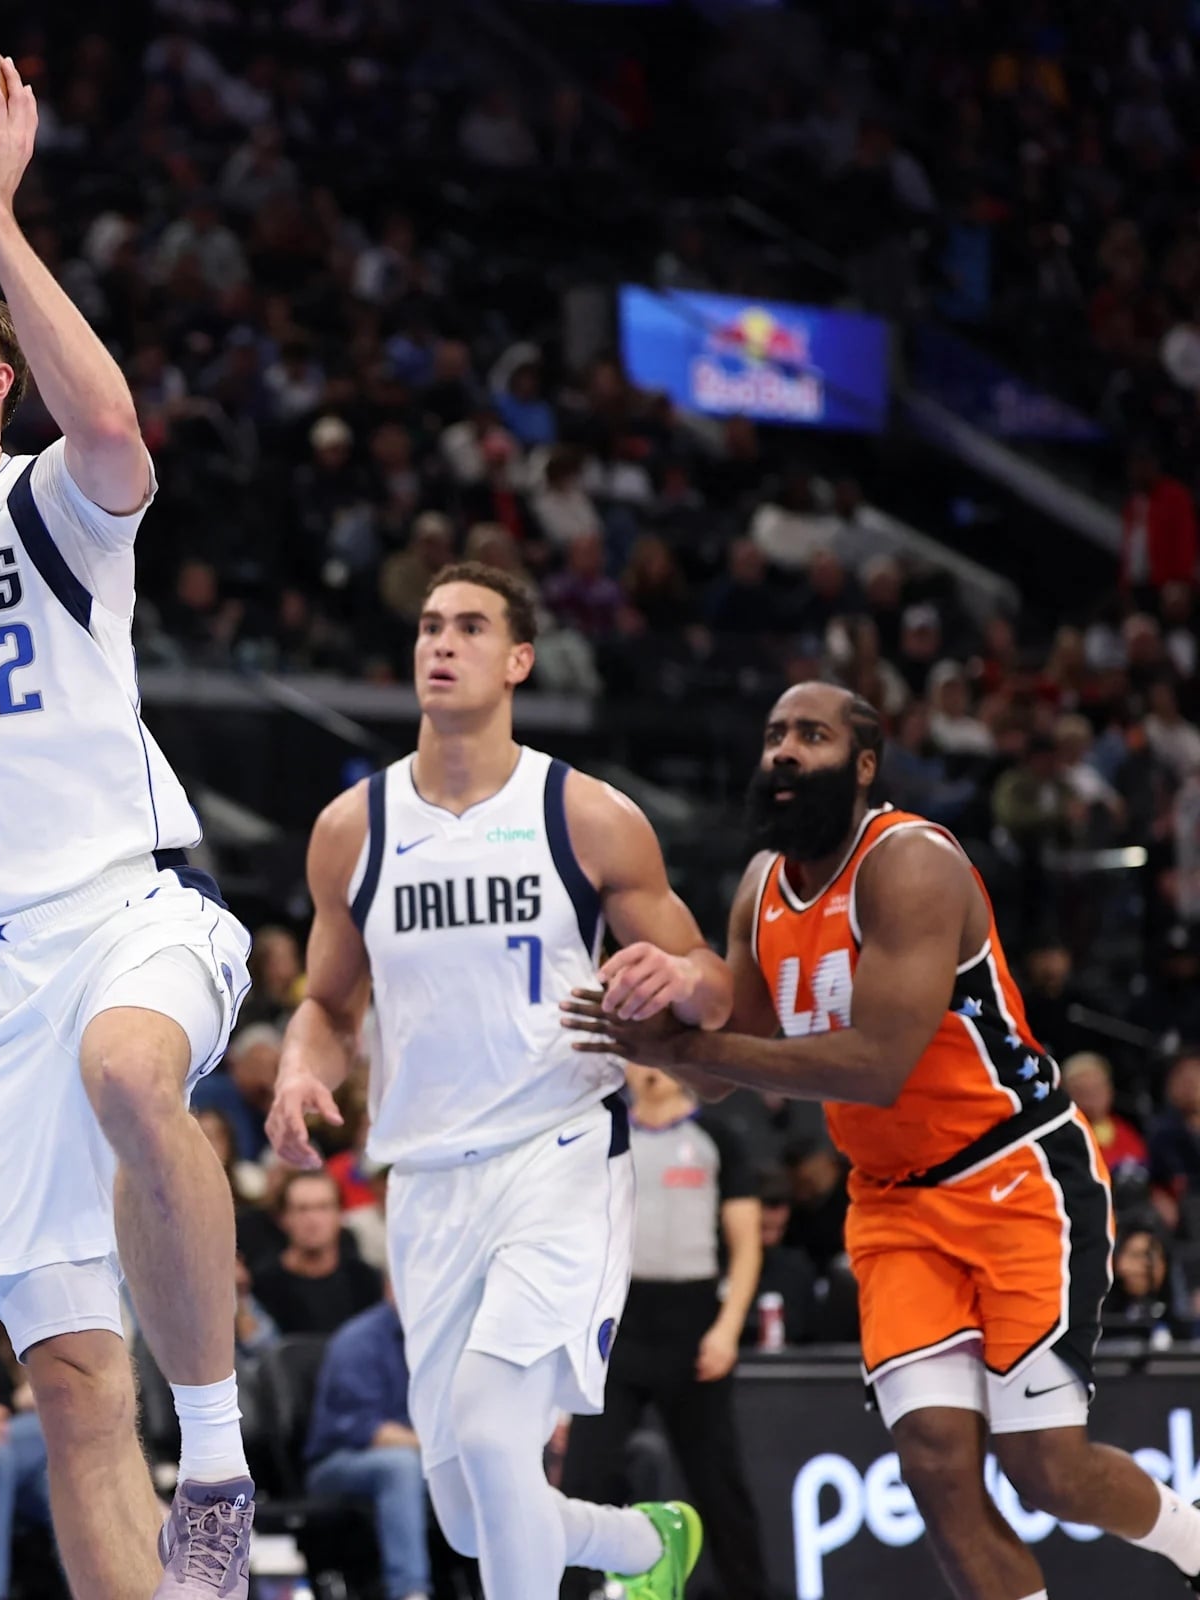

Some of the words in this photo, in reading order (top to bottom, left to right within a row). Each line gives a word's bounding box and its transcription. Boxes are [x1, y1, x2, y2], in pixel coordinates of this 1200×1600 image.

[486, 827, 536, 843] chime
[394, 873, 542, 934] DALLAS
[505, 934, 543, 1006] 7
[776, 948, 854, 1038] LA
